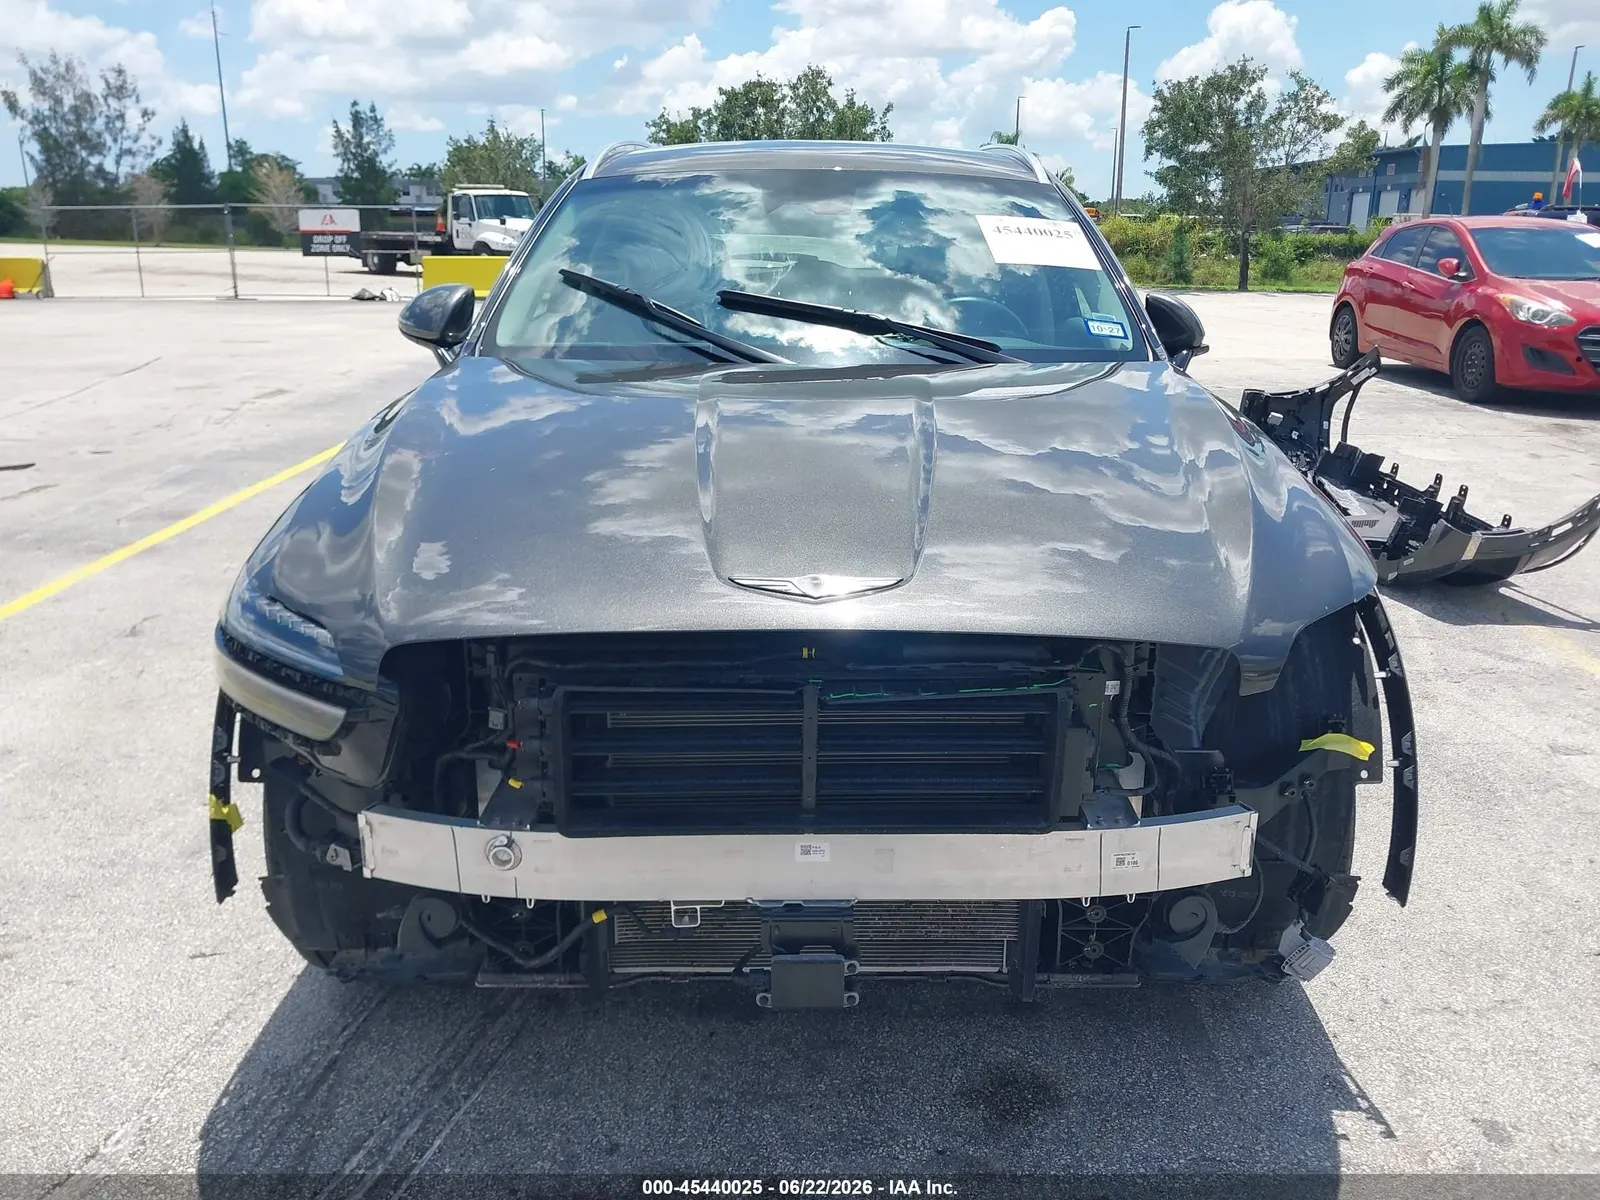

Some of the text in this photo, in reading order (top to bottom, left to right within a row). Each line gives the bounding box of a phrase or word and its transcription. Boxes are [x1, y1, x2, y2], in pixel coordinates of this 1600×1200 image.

[992, 225, 1074, 240] 45440025
[312, 235, 348, 244] DROP OFF
[310, 244, 351, 253] ZONE ONLY
[1091, 325, 1120, 334] 10-27
